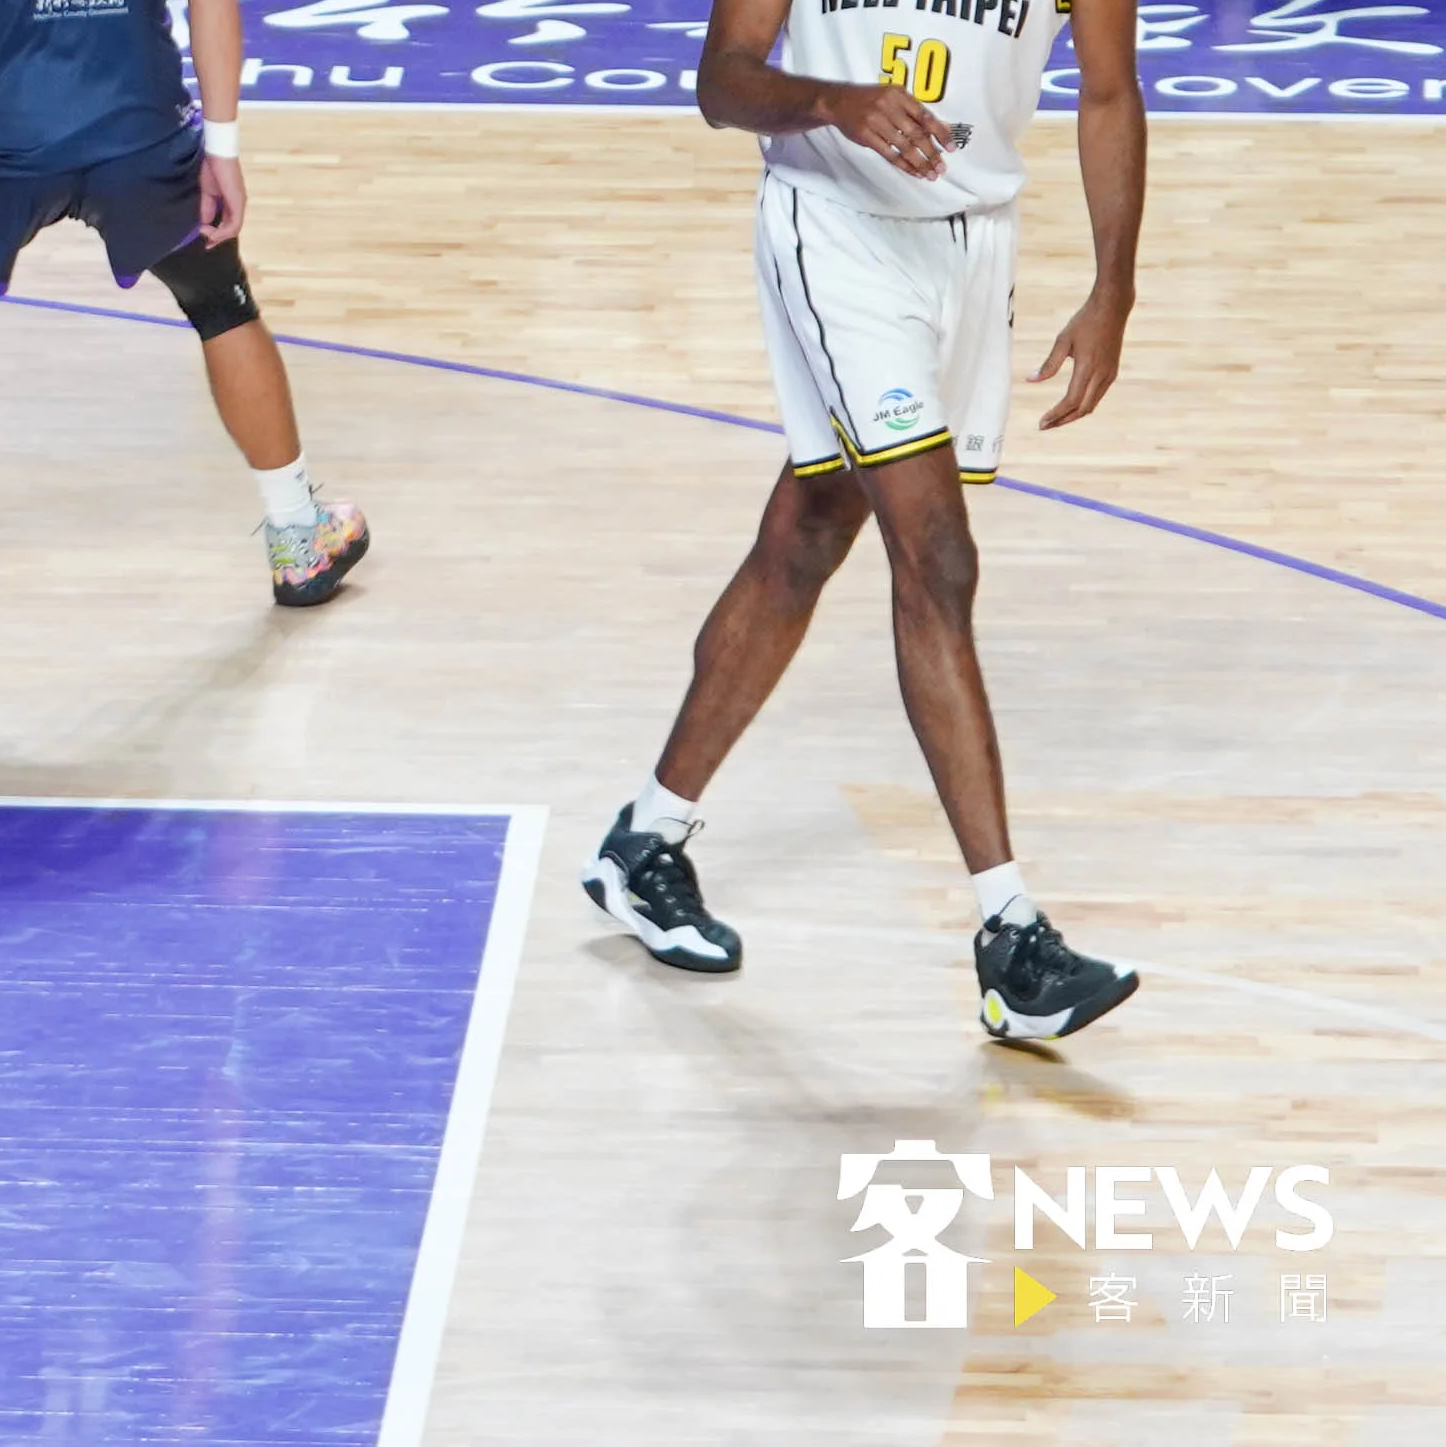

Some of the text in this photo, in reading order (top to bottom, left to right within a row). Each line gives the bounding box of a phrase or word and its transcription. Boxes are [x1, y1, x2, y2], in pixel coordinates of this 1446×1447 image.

[878, 31, 952, 104] 50
[873, 401, 925, 422] JM Eagle
